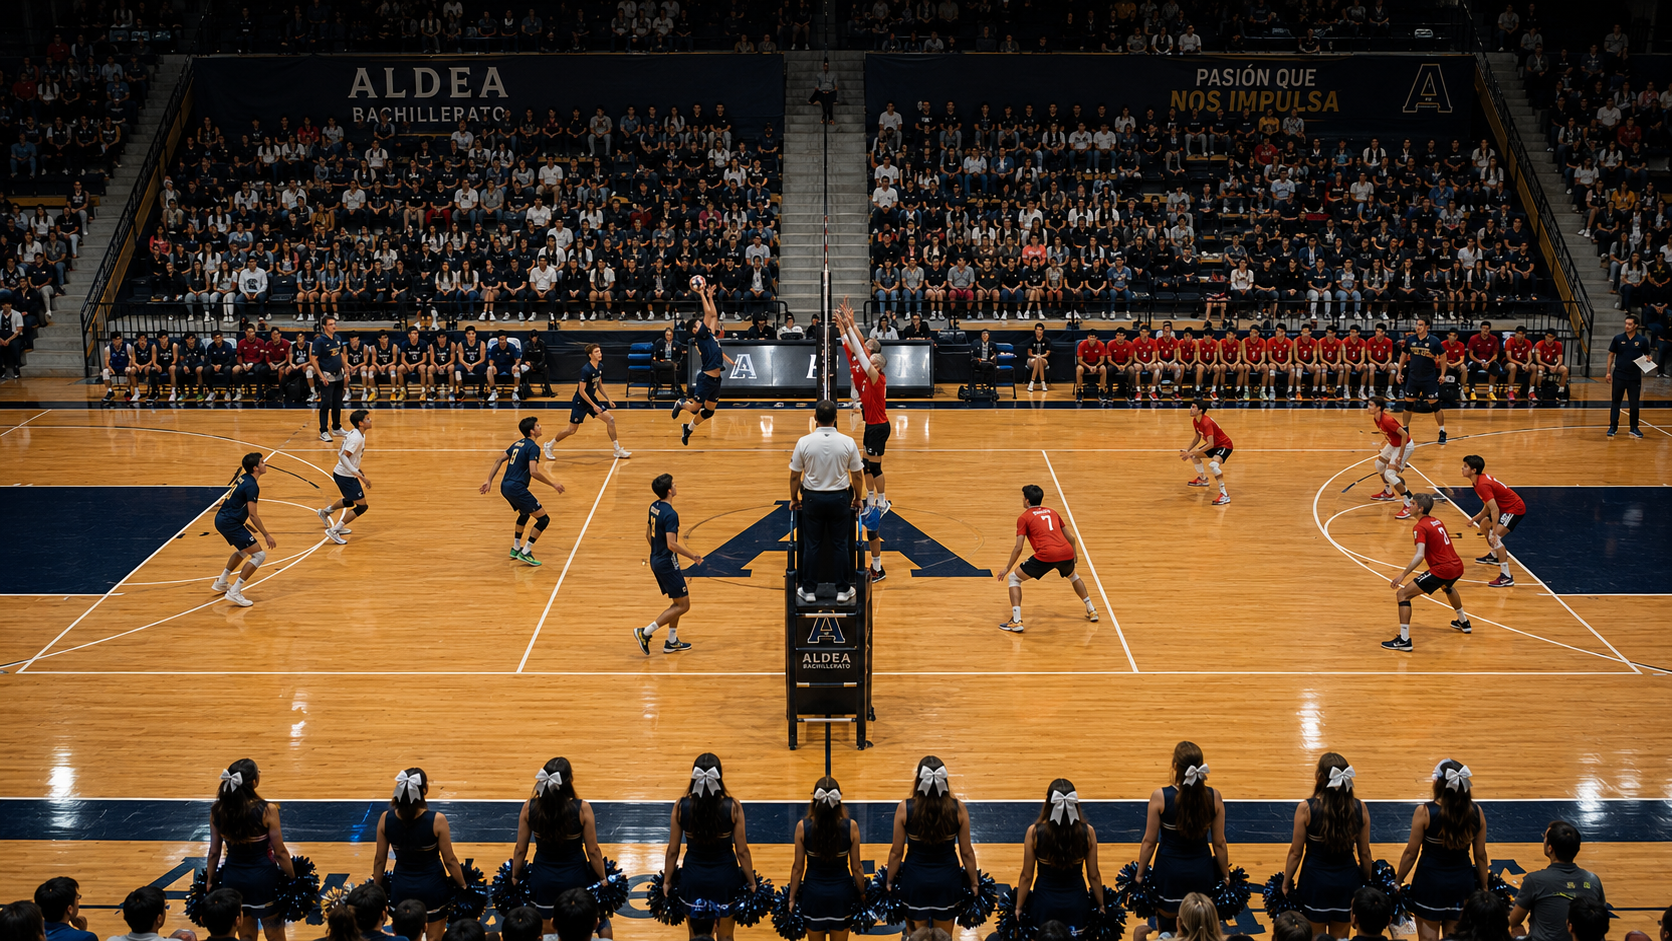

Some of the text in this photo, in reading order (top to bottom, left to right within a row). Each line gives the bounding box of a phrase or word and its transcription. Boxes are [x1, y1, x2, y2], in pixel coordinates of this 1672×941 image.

[347, 66, 509, 99] ALDEA
[1195, 64, 1317, 89] PASIÓN QUE
[1402, 63, 1453, 114] A
[1170, 90, 1340, 113] NOS IMPULSA
[729, 353, 758, 380] A
[1040, 514, 1054, 532] 7
[1437, 526, 1451, 546] 2
[807, 609, 846, 644] A
[802, 653, 851, 663] ALDEA
